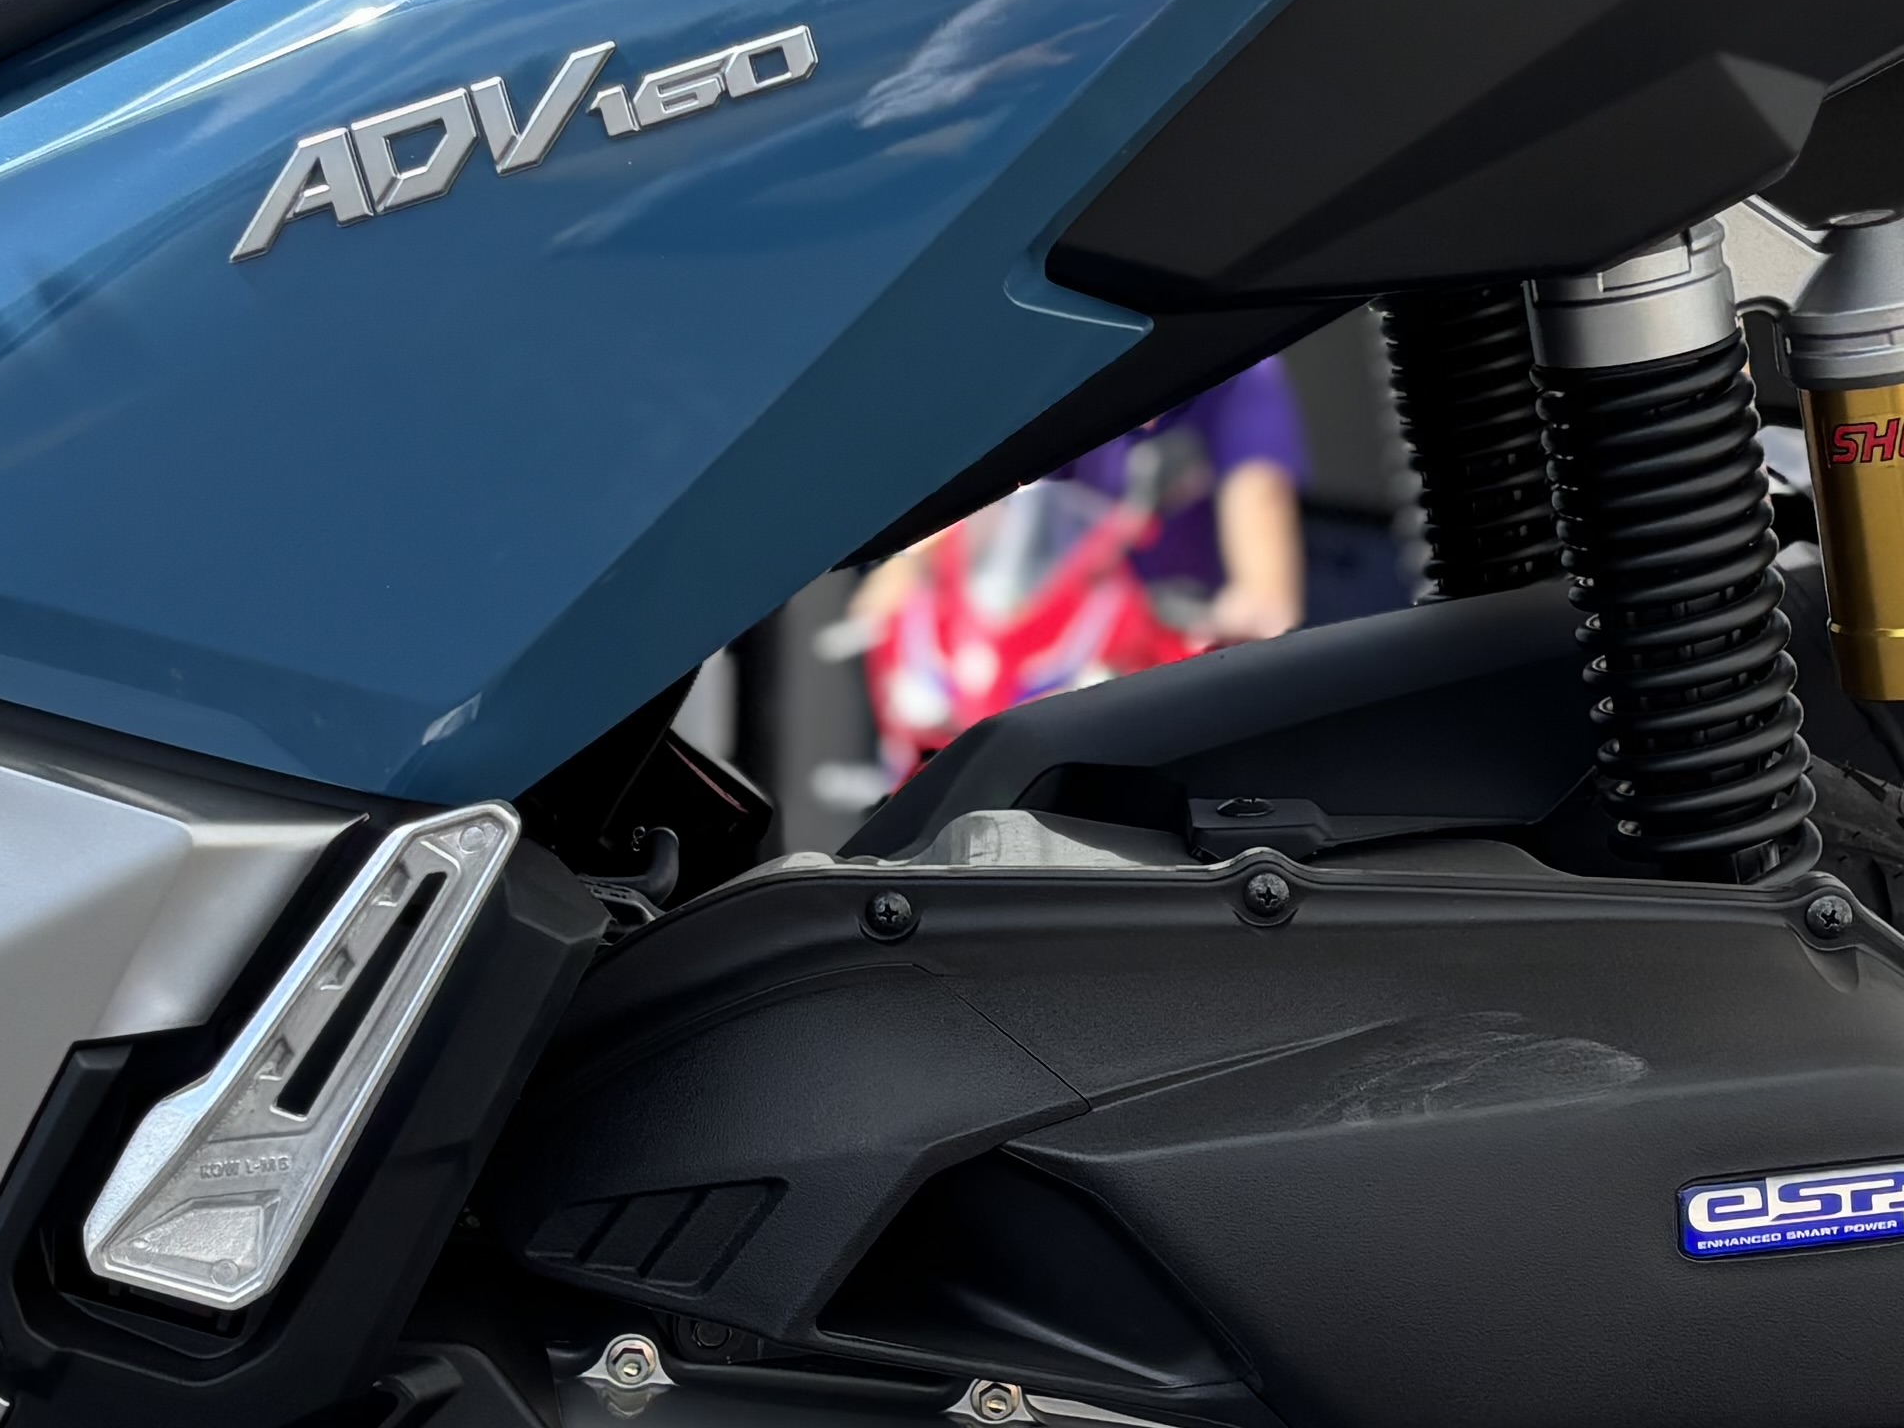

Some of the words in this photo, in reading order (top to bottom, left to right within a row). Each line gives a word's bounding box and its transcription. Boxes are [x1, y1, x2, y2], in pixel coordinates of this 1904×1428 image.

[1696, 1231, 1782, 1250] ENHANCED
[1786, 1224, 1840, 1241] SMART
[1843, 1219, 1899, 1235] POWER
